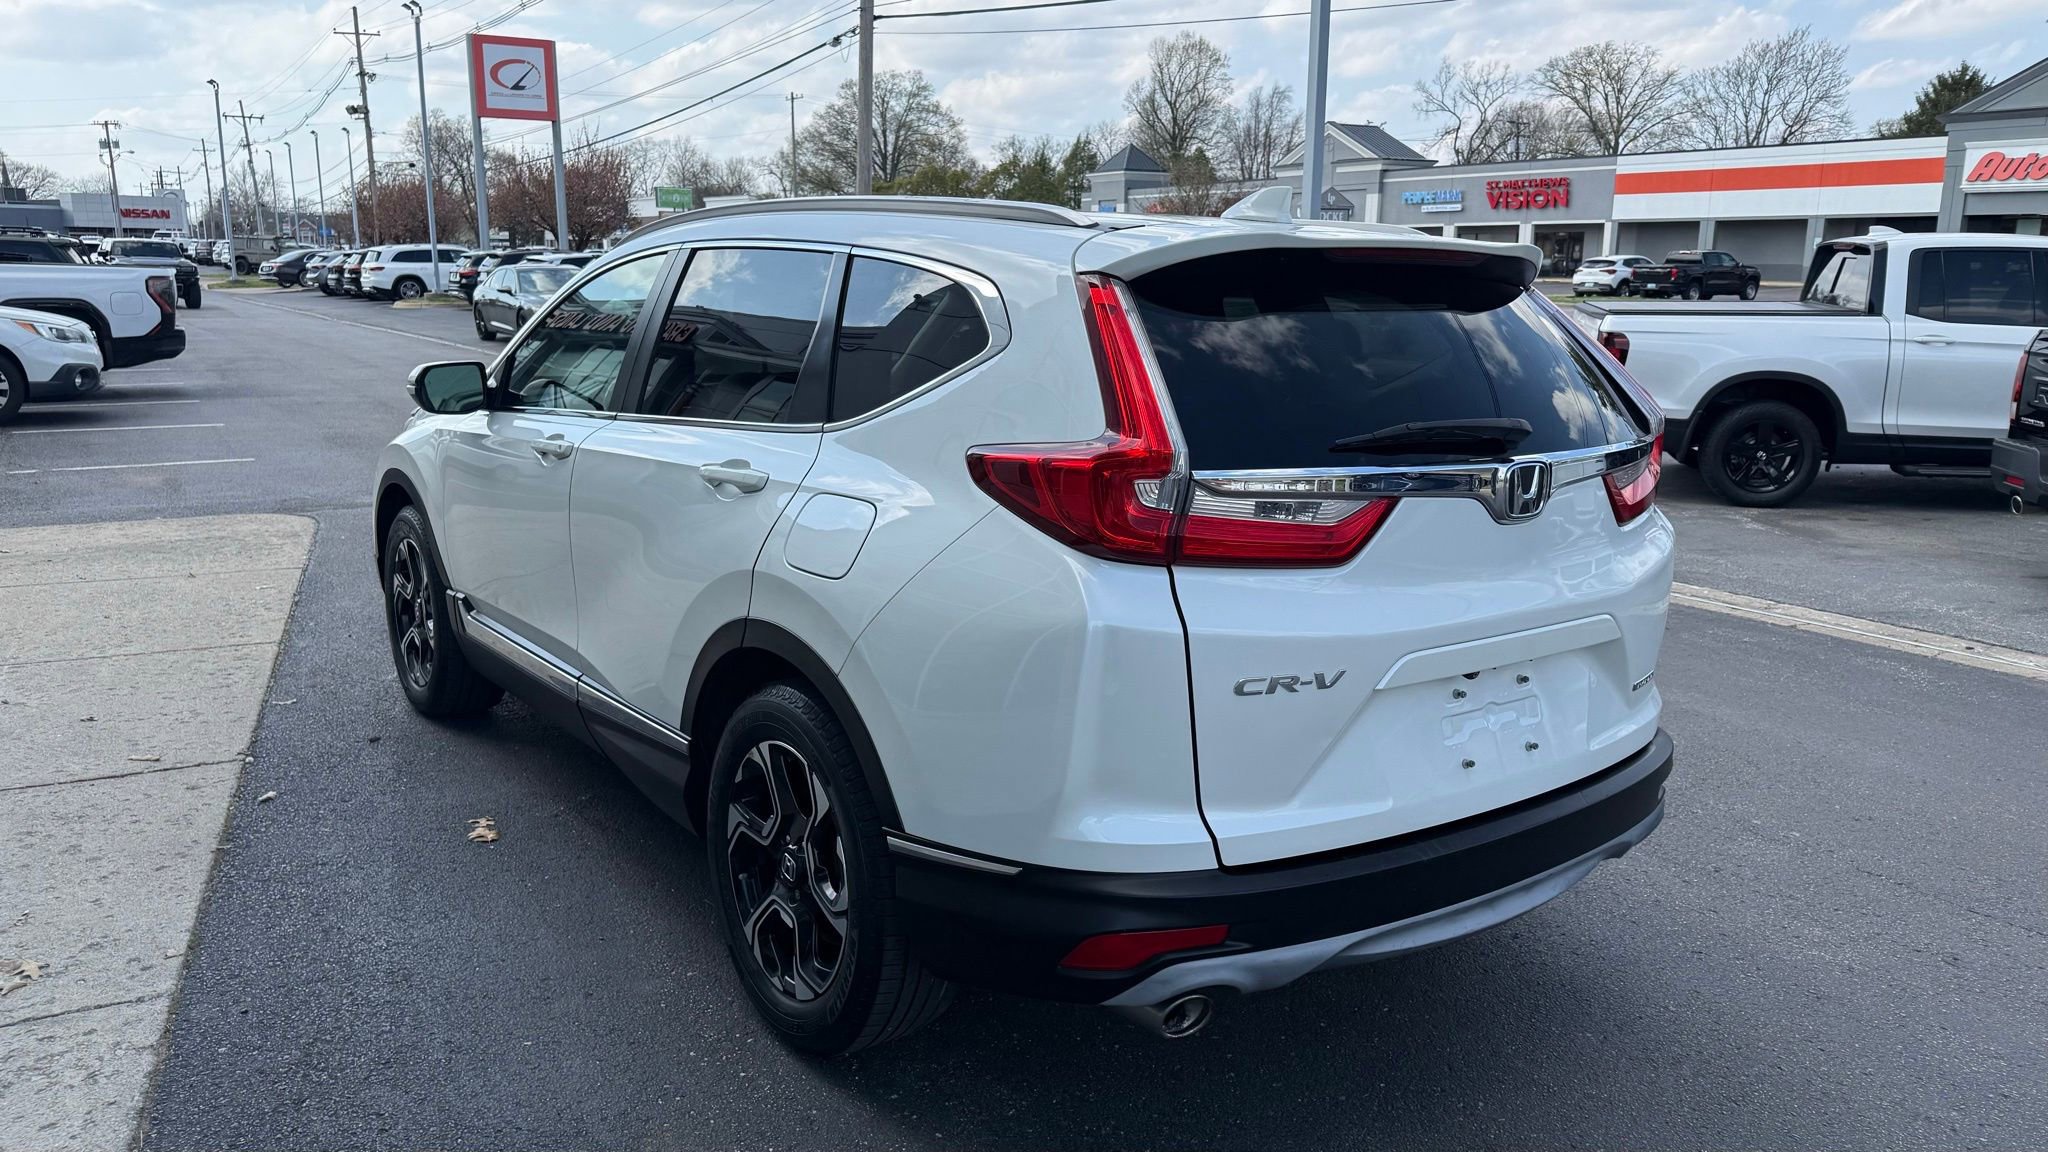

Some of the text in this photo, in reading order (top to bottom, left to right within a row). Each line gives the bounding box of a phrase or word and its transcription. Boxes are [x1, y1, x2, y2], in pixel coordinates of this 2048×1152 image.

[1966, 151, 2048, 183] Auto
[1503, 177, 1569, 190] MATTHEWS
[1486, 188, 1569, 209] VISION
[119, 208, 171, 219] NISSAN
[1233, 668, 1347, 697] CR-V
